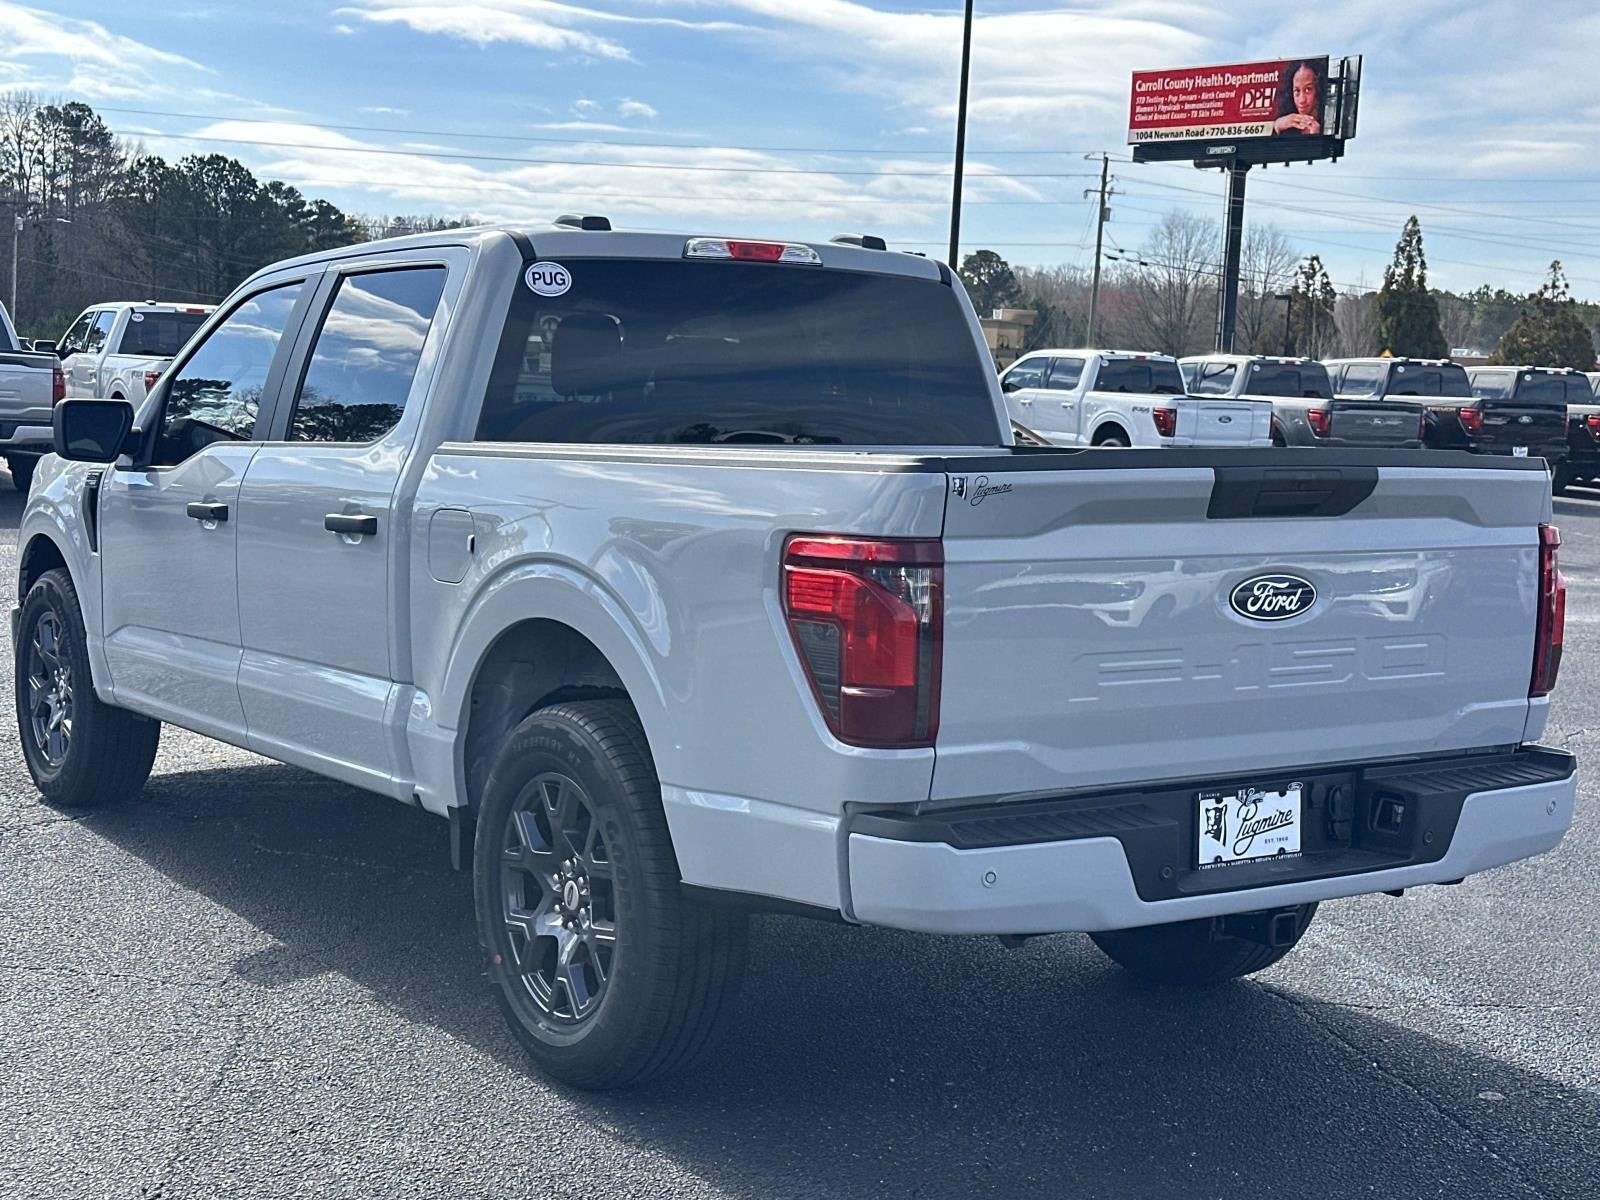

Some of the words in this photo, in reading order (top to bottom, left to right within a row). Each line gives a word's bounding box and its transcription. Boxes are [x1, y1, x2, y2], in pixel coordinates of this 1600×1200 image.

[1135, 78, 1163, 91] Carroll
[1164, 77, 1194, 91] County
[1194, 73, 1223, 88] Health
[1224, 70, 1279, 88] Department
[1135, 131, 1153, 140] 1004
[1154, 129, 1184, 139] Newnan
[1185, 127, 1205, 138] Road
[1210, 125, 1265, 137] 770-836-6667
[531, 271, 567, 286] PUG
[970, 475, 1013, 506] Pugmire
[1247, 581, 1302, 611] Ford
[1233, 802, 1294, 856] Pugmire
